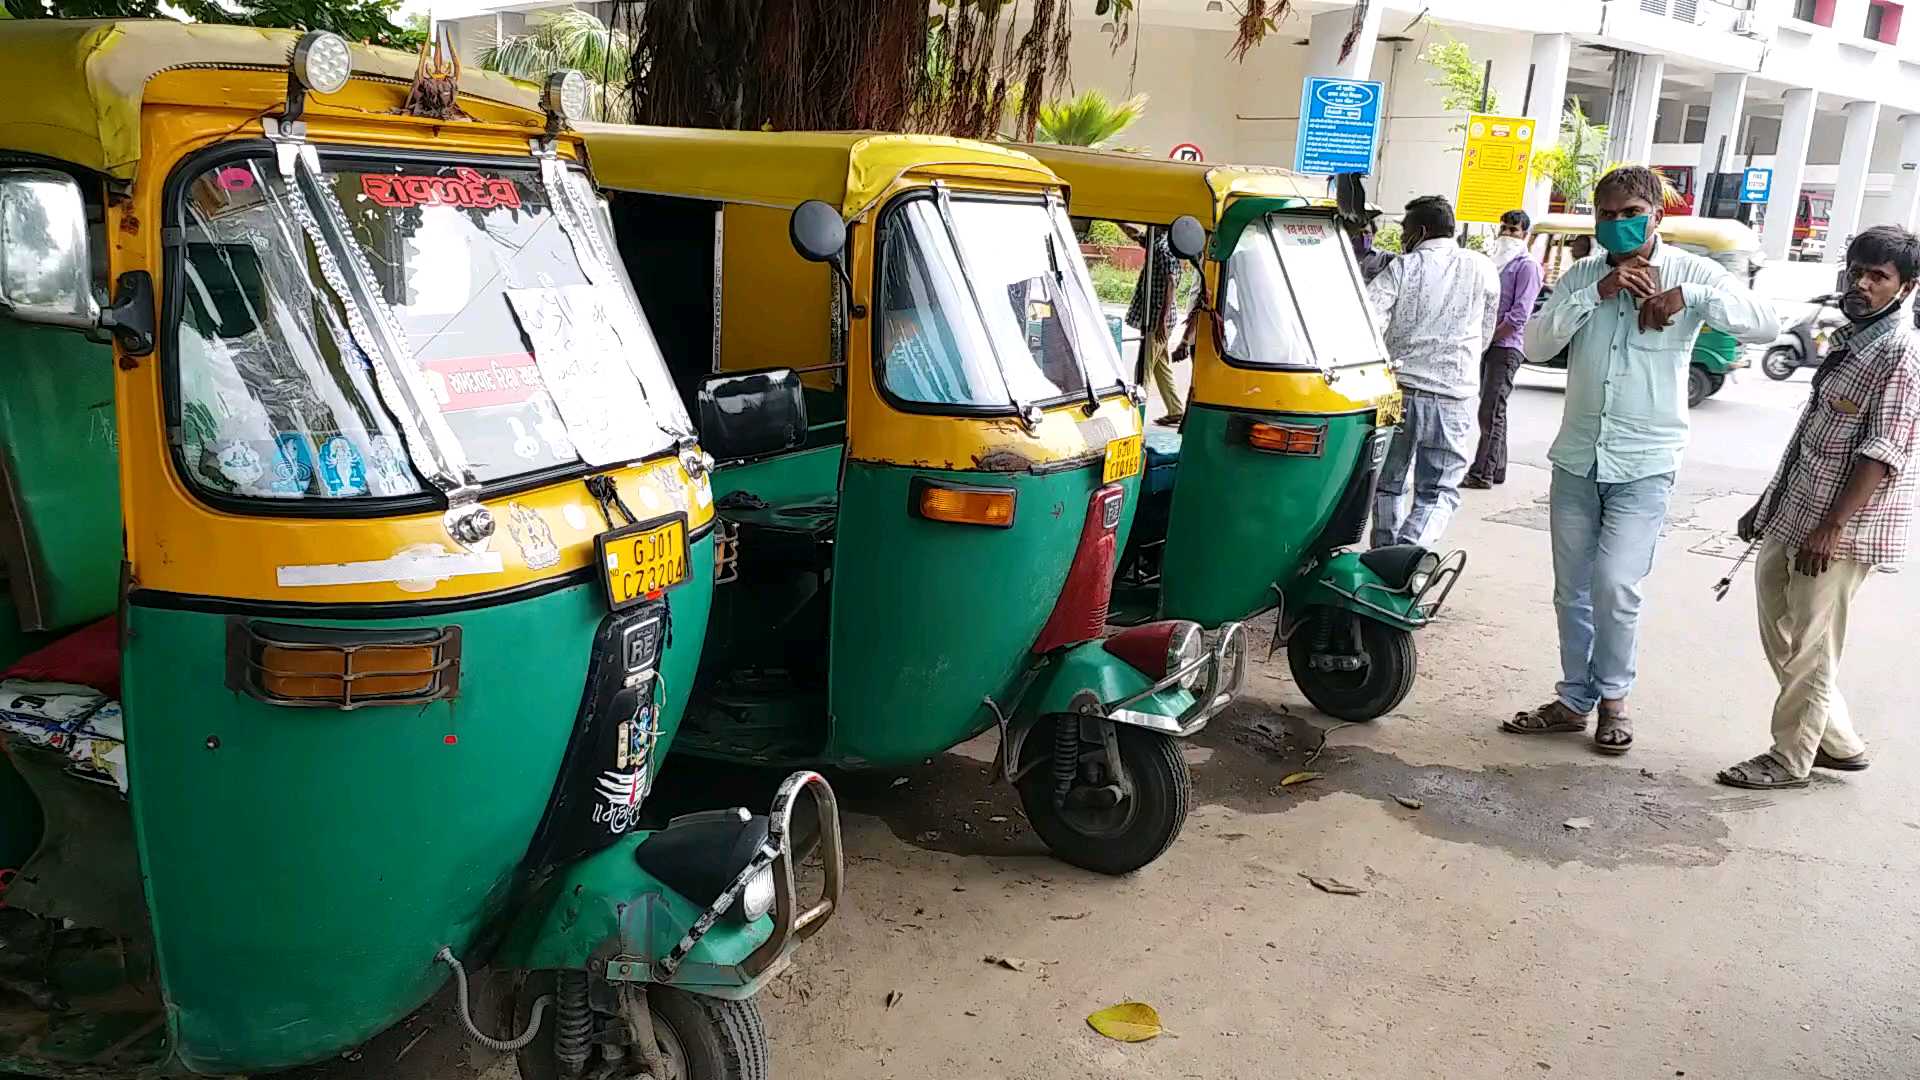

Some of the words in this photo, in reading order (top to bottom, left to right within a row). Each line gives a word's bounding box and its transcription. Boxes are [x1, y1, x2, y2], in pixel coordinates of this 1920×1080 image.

[634, 529, 672, 565] GJ01
[623, 555, 683, 599] CZ3204
[631, 634, 654, 663] RE
